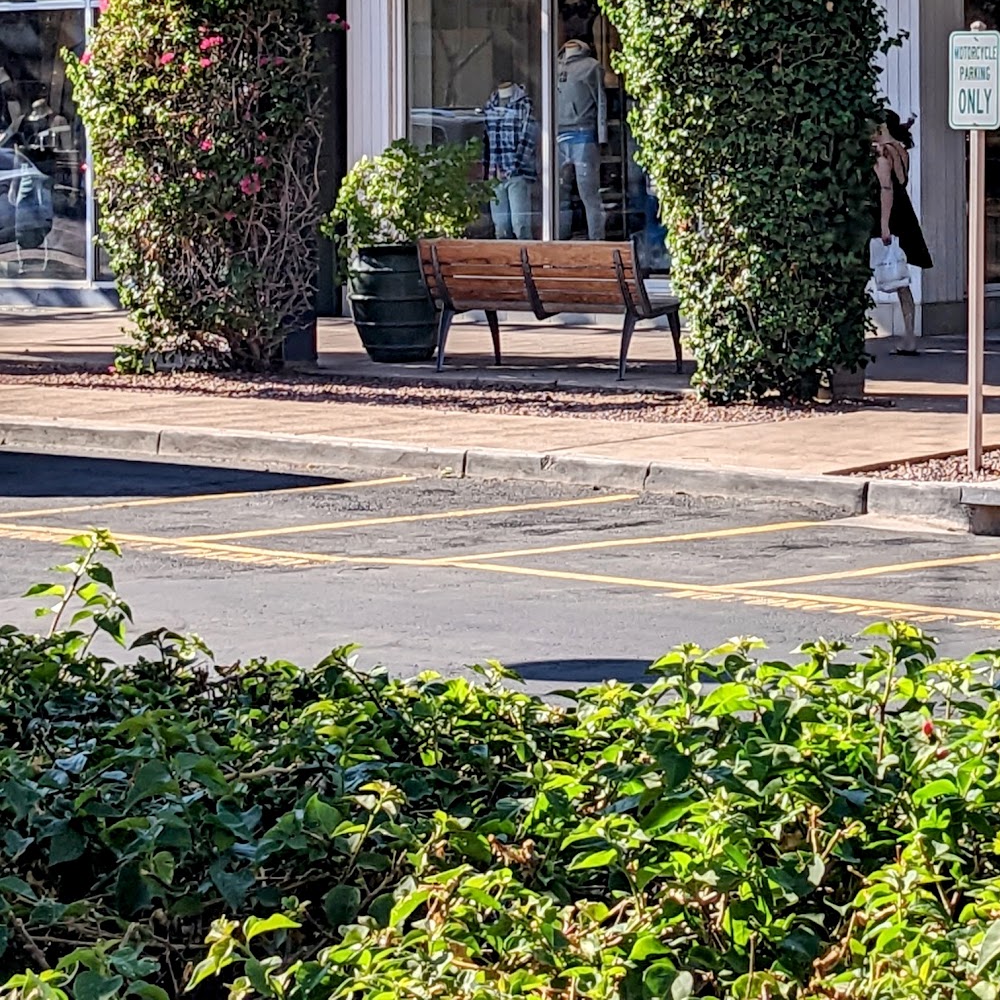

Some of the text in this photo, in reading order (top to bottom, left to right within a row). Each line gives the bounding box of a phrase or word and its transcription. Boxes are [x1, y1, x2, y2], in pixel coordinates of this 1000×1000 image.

[955, 46, 997, 60] MOTORCYCLE
[960, 66, 991, 80] PARKING
[958, 88, 992, 114] ONLY
